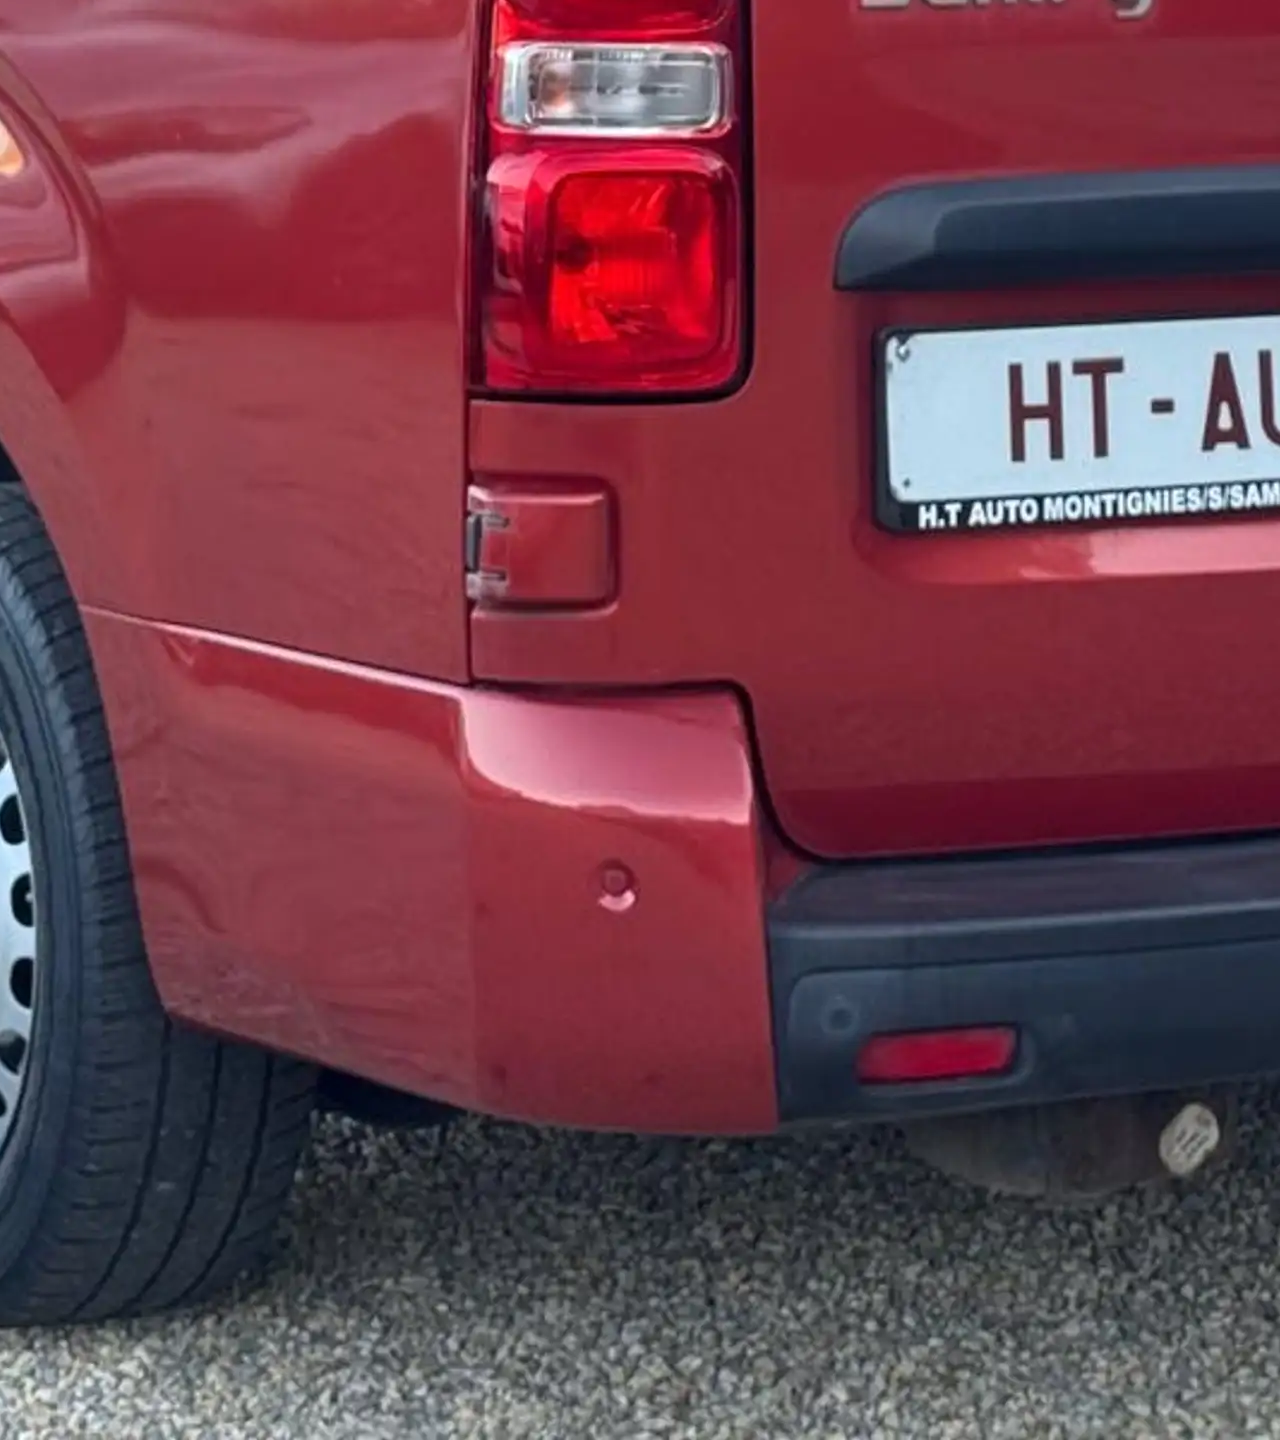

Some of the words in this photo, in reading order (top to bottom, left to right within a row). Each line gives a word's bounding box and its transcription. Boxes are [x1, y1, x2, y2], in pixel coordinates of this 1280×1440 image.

[1008, 357, 1125, 462] HT
[918, 502, 962, 529] H.T
[968, 498, 1039, 526] AUTO
